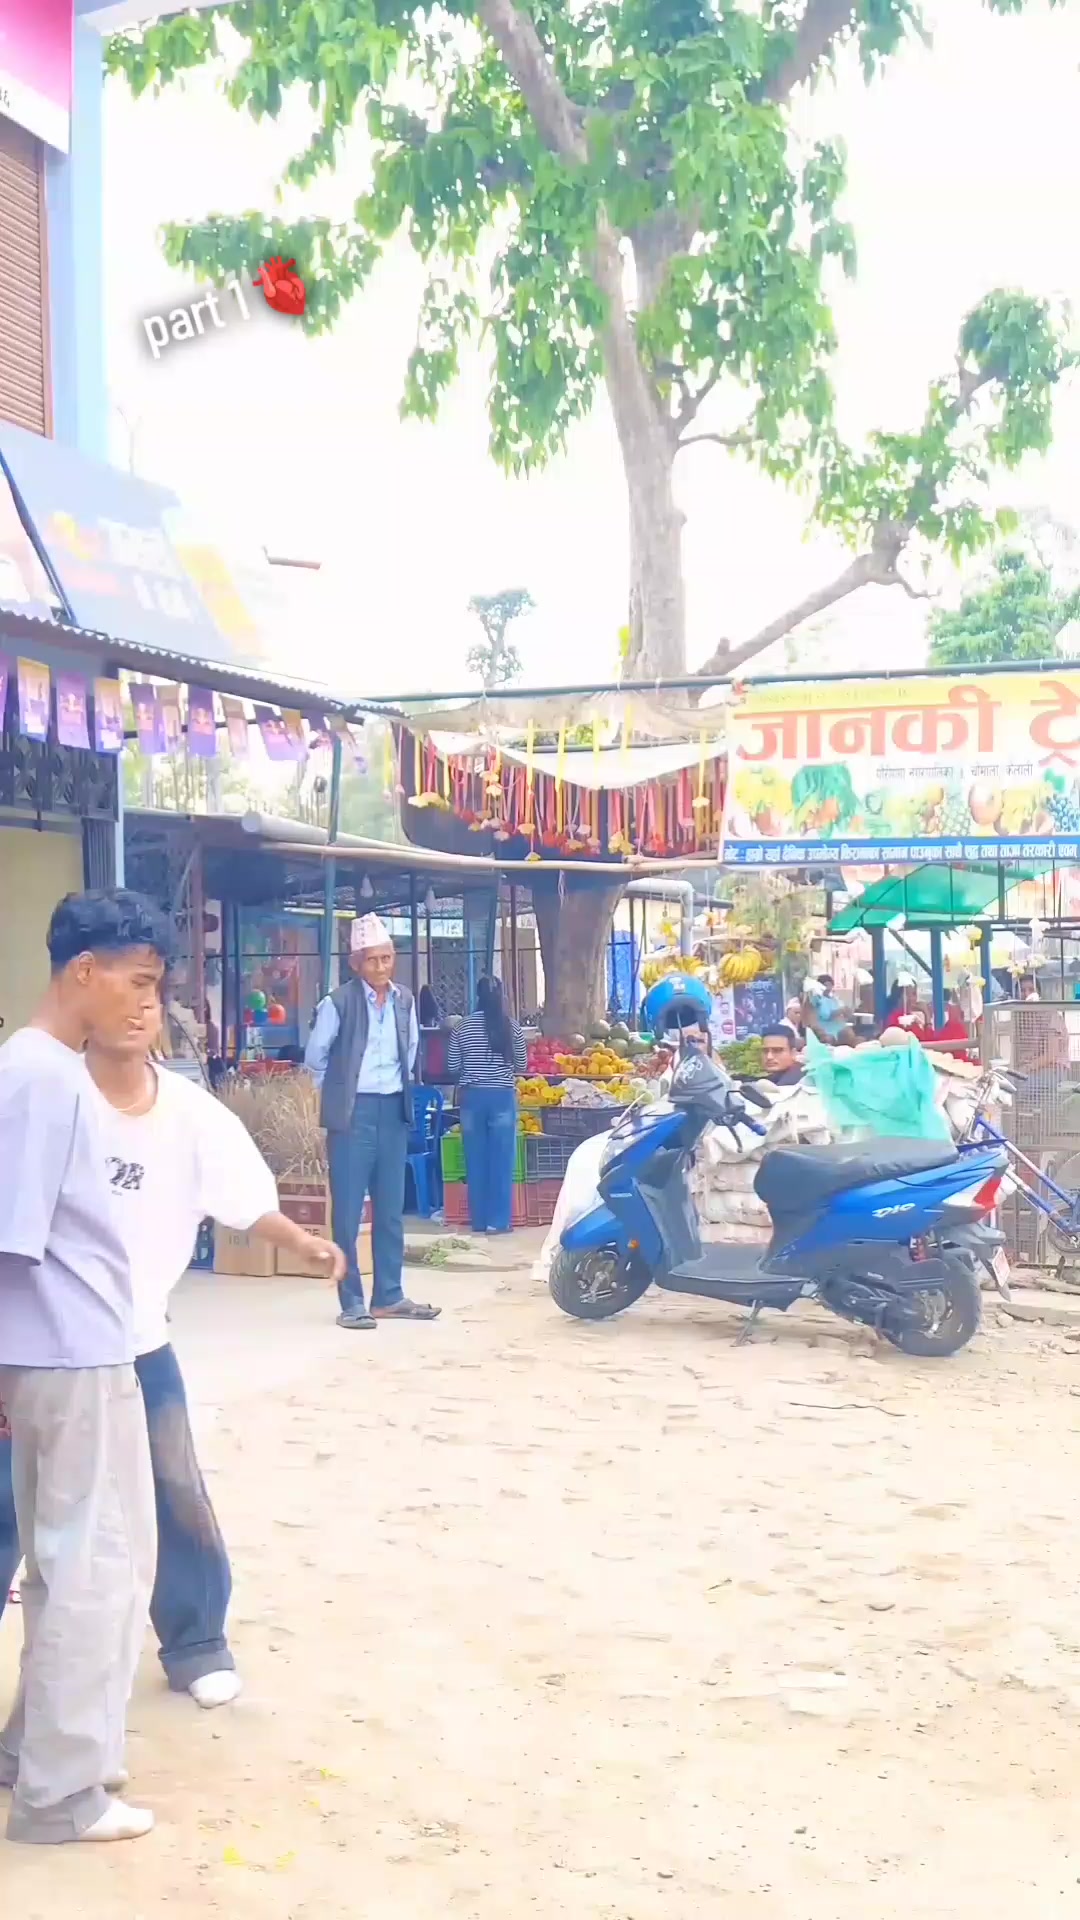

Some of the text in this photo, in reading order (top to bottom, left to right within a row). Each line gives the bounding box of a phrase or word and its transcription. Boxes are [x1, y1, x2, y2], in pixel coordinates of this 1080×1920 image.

[734, 683, 1002, 761] जानकी
[980, 844, 999, 859] तथा
[1022, 839, 1056, 859] तरकारी
